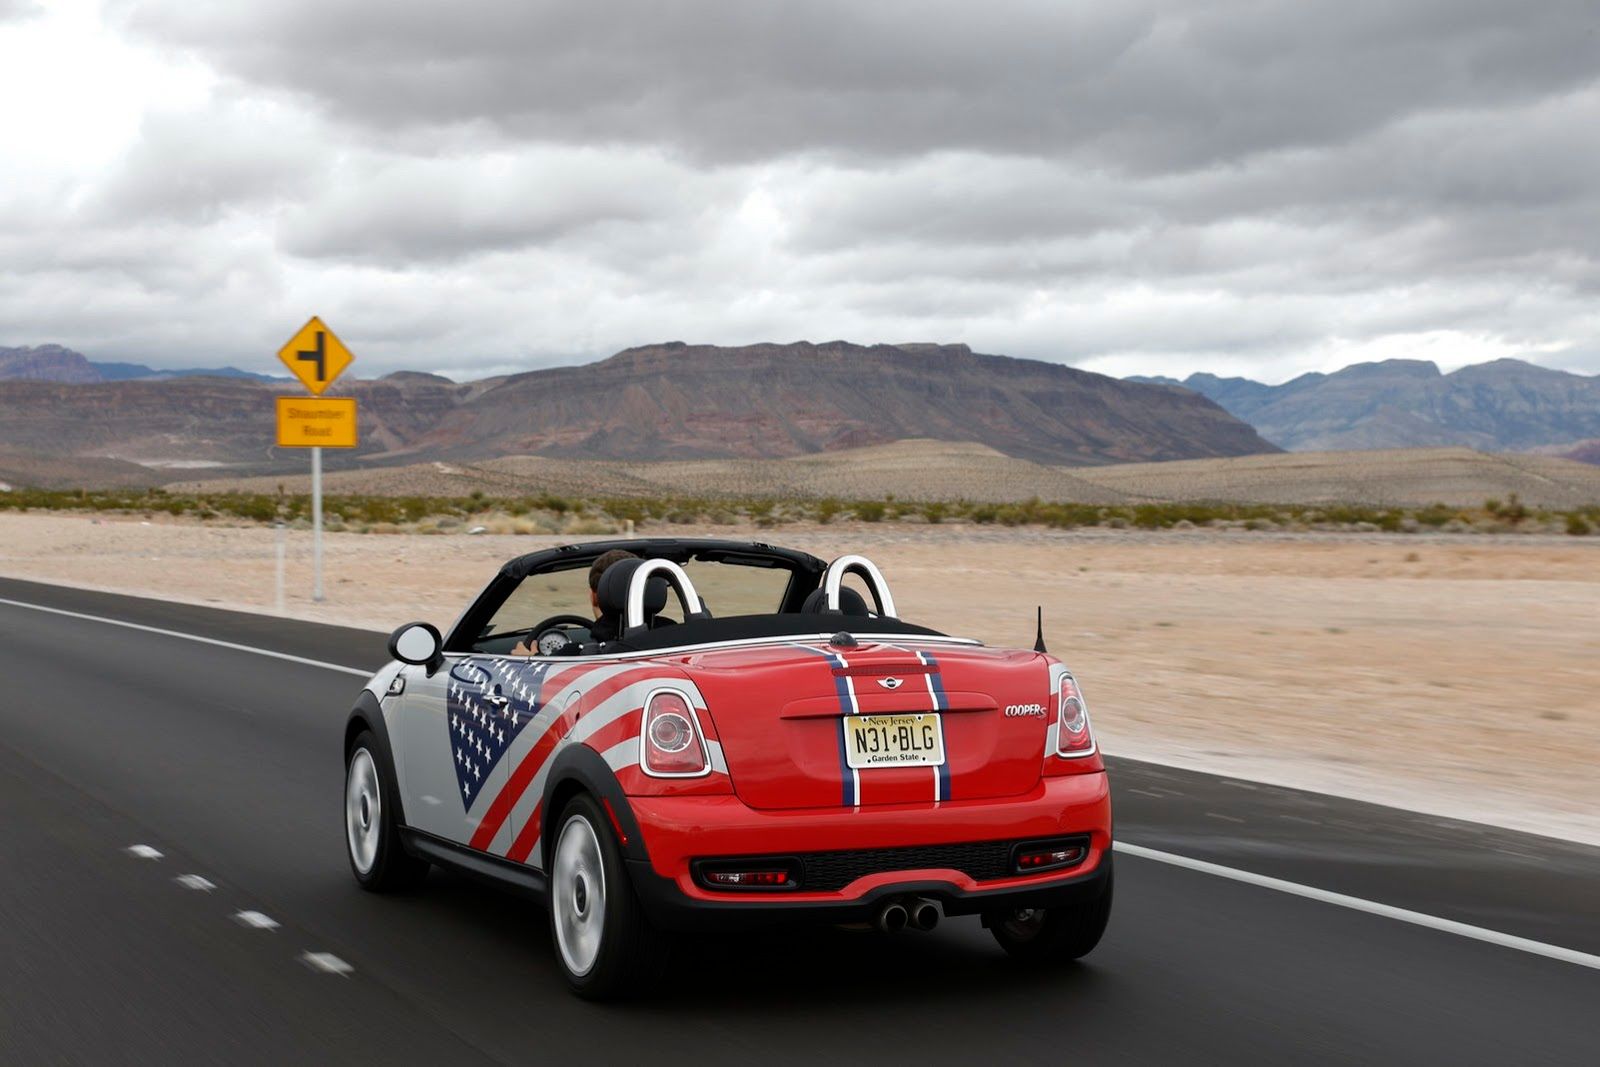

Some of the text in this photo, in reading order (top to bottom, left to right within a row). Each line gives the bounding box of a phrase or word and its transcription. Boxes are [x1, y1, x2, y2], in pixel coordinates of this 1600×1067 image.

[868, 716, 916, 727] New Jersey
[871, 753, 919, 762] Garden State
